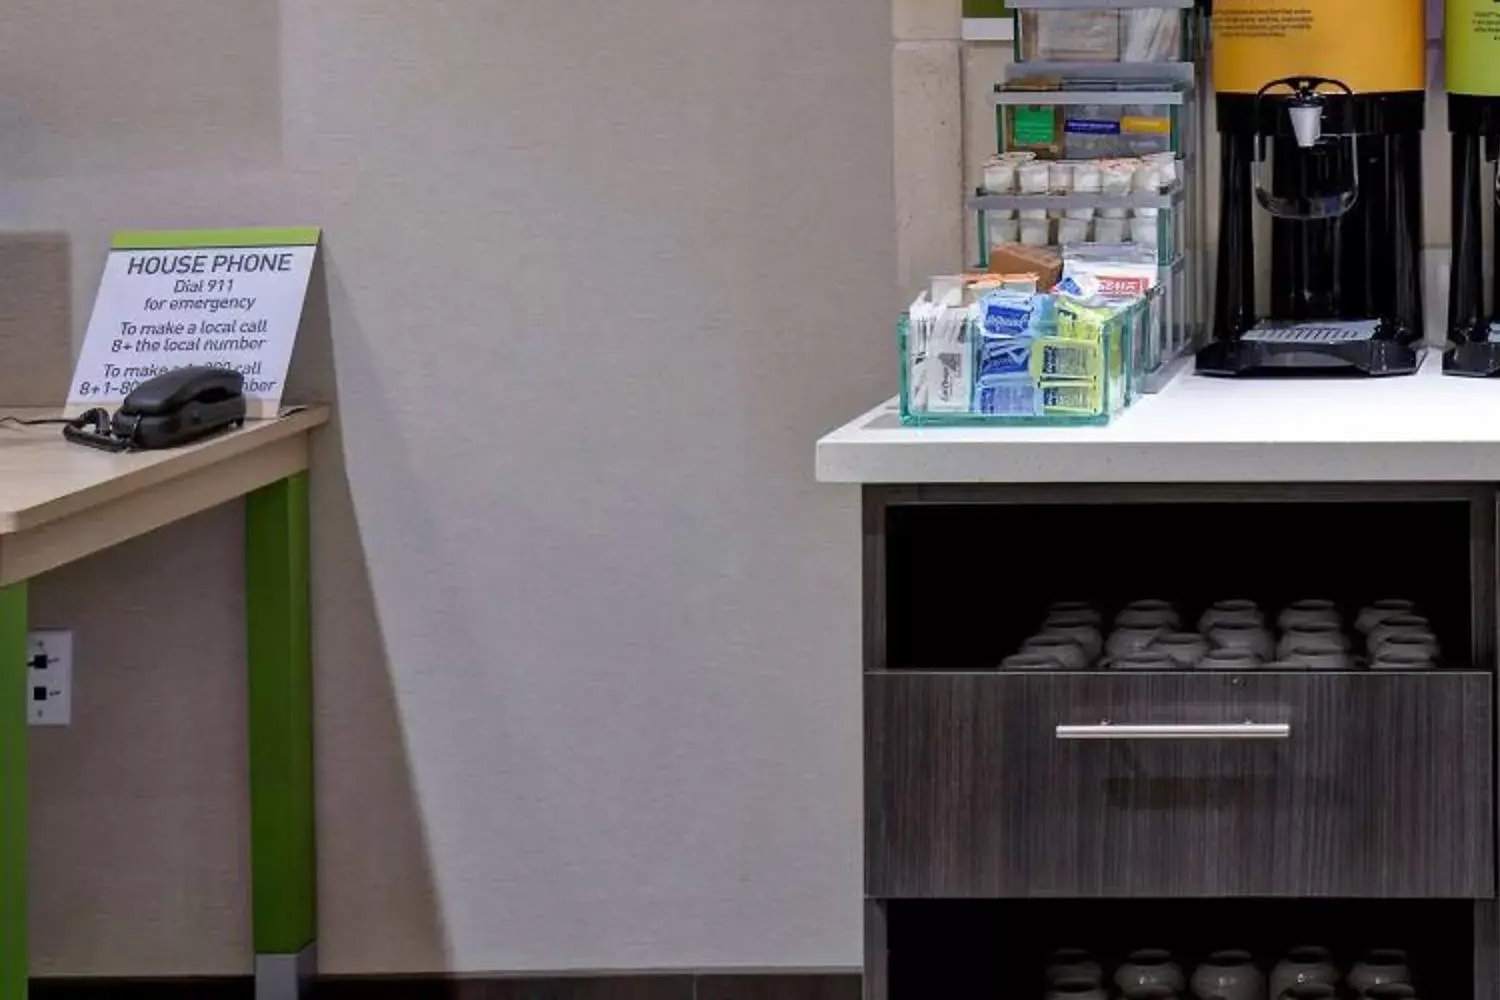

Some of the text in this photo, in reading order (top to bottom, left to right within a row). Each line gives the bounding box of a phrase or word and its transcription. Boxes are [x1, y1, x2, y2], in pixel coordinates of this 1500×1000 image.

[127, 253, 293, 275] HOUSE PHONE
[174, 278, 233, 293] Dial 911
[144, 297, 256, 312] for emergency
[121, 319, 267, 335] To make a local call
[136, 338, 160, 352] the
[163, 338, 200, 351] local
[203, 338, 267, 351] number
[103, 363, 120, 378] To
[123, 362, 168, 377] make
